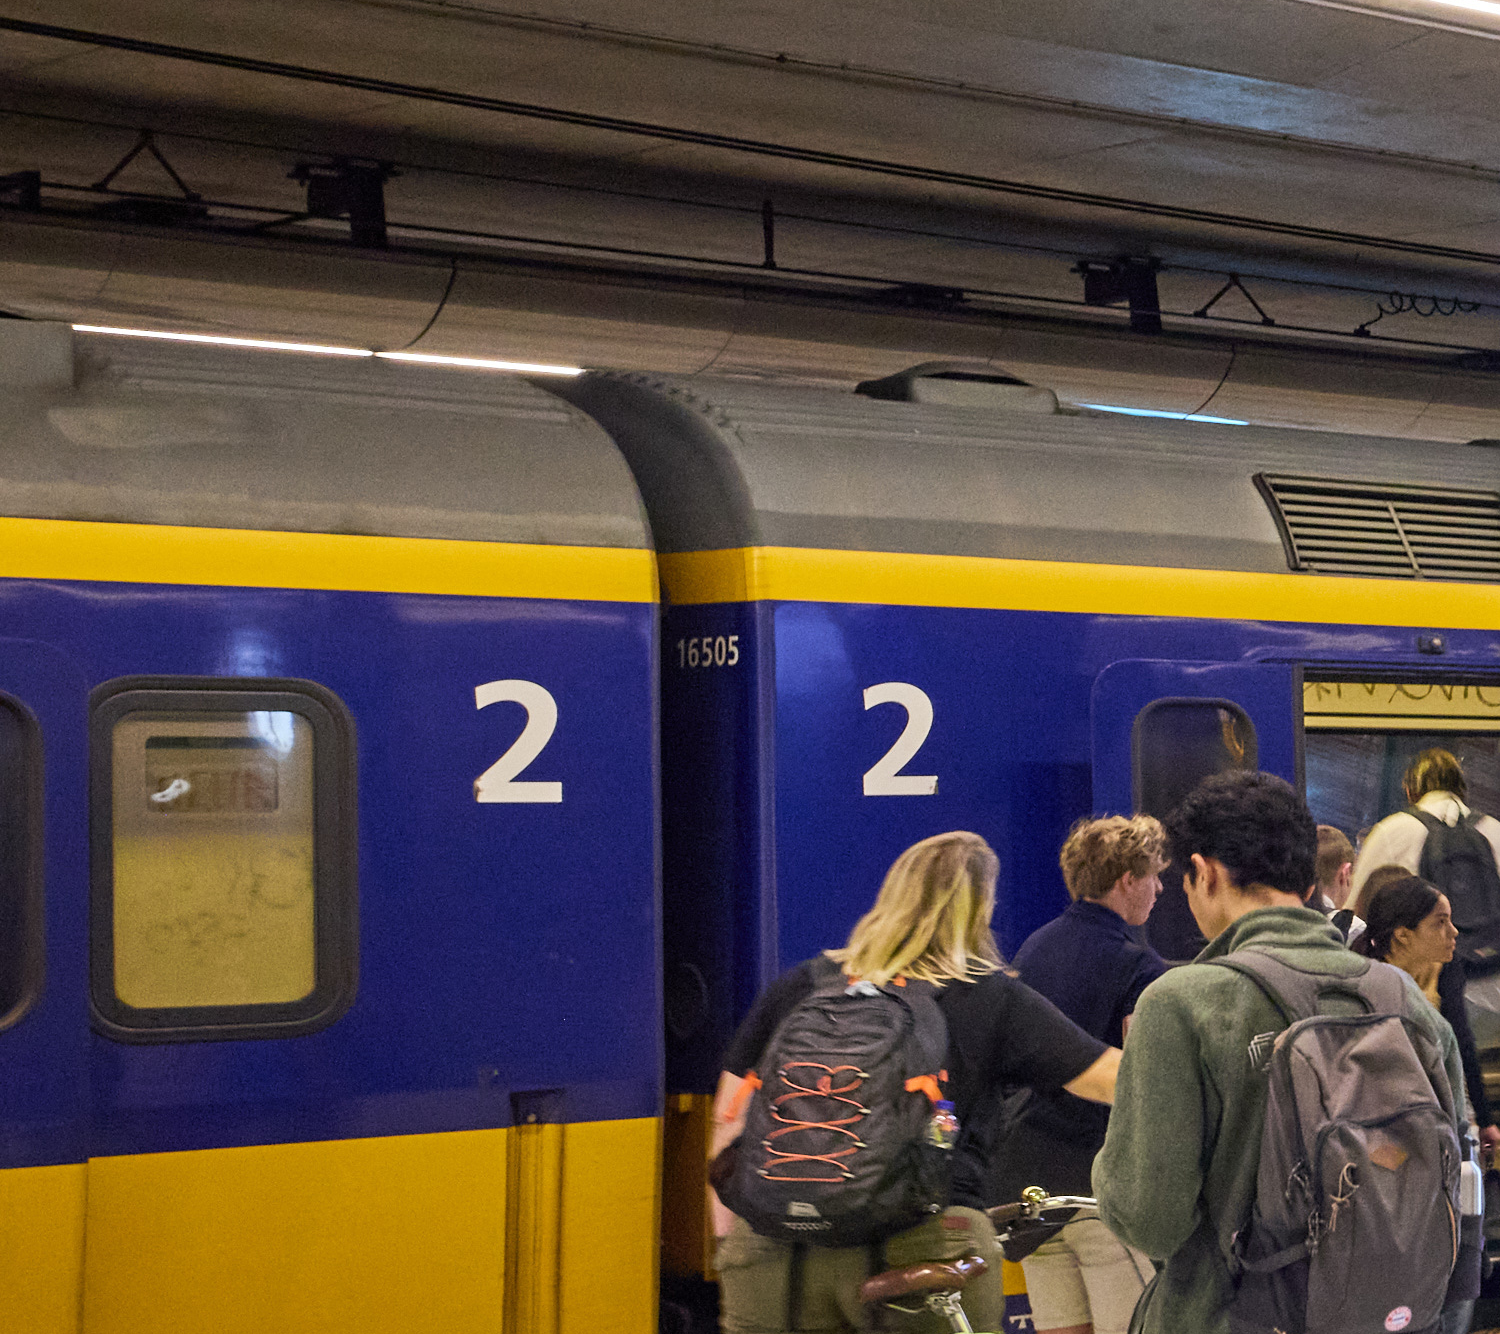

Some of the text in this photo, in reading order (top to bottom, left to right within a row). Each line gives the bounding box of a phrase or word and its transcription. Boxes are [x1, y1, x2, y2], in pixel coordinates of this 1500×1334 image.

[677, 634, 740, 668] 16505
[474, 678, 564, 805] 2
[861, 681, 939, 798] 2
